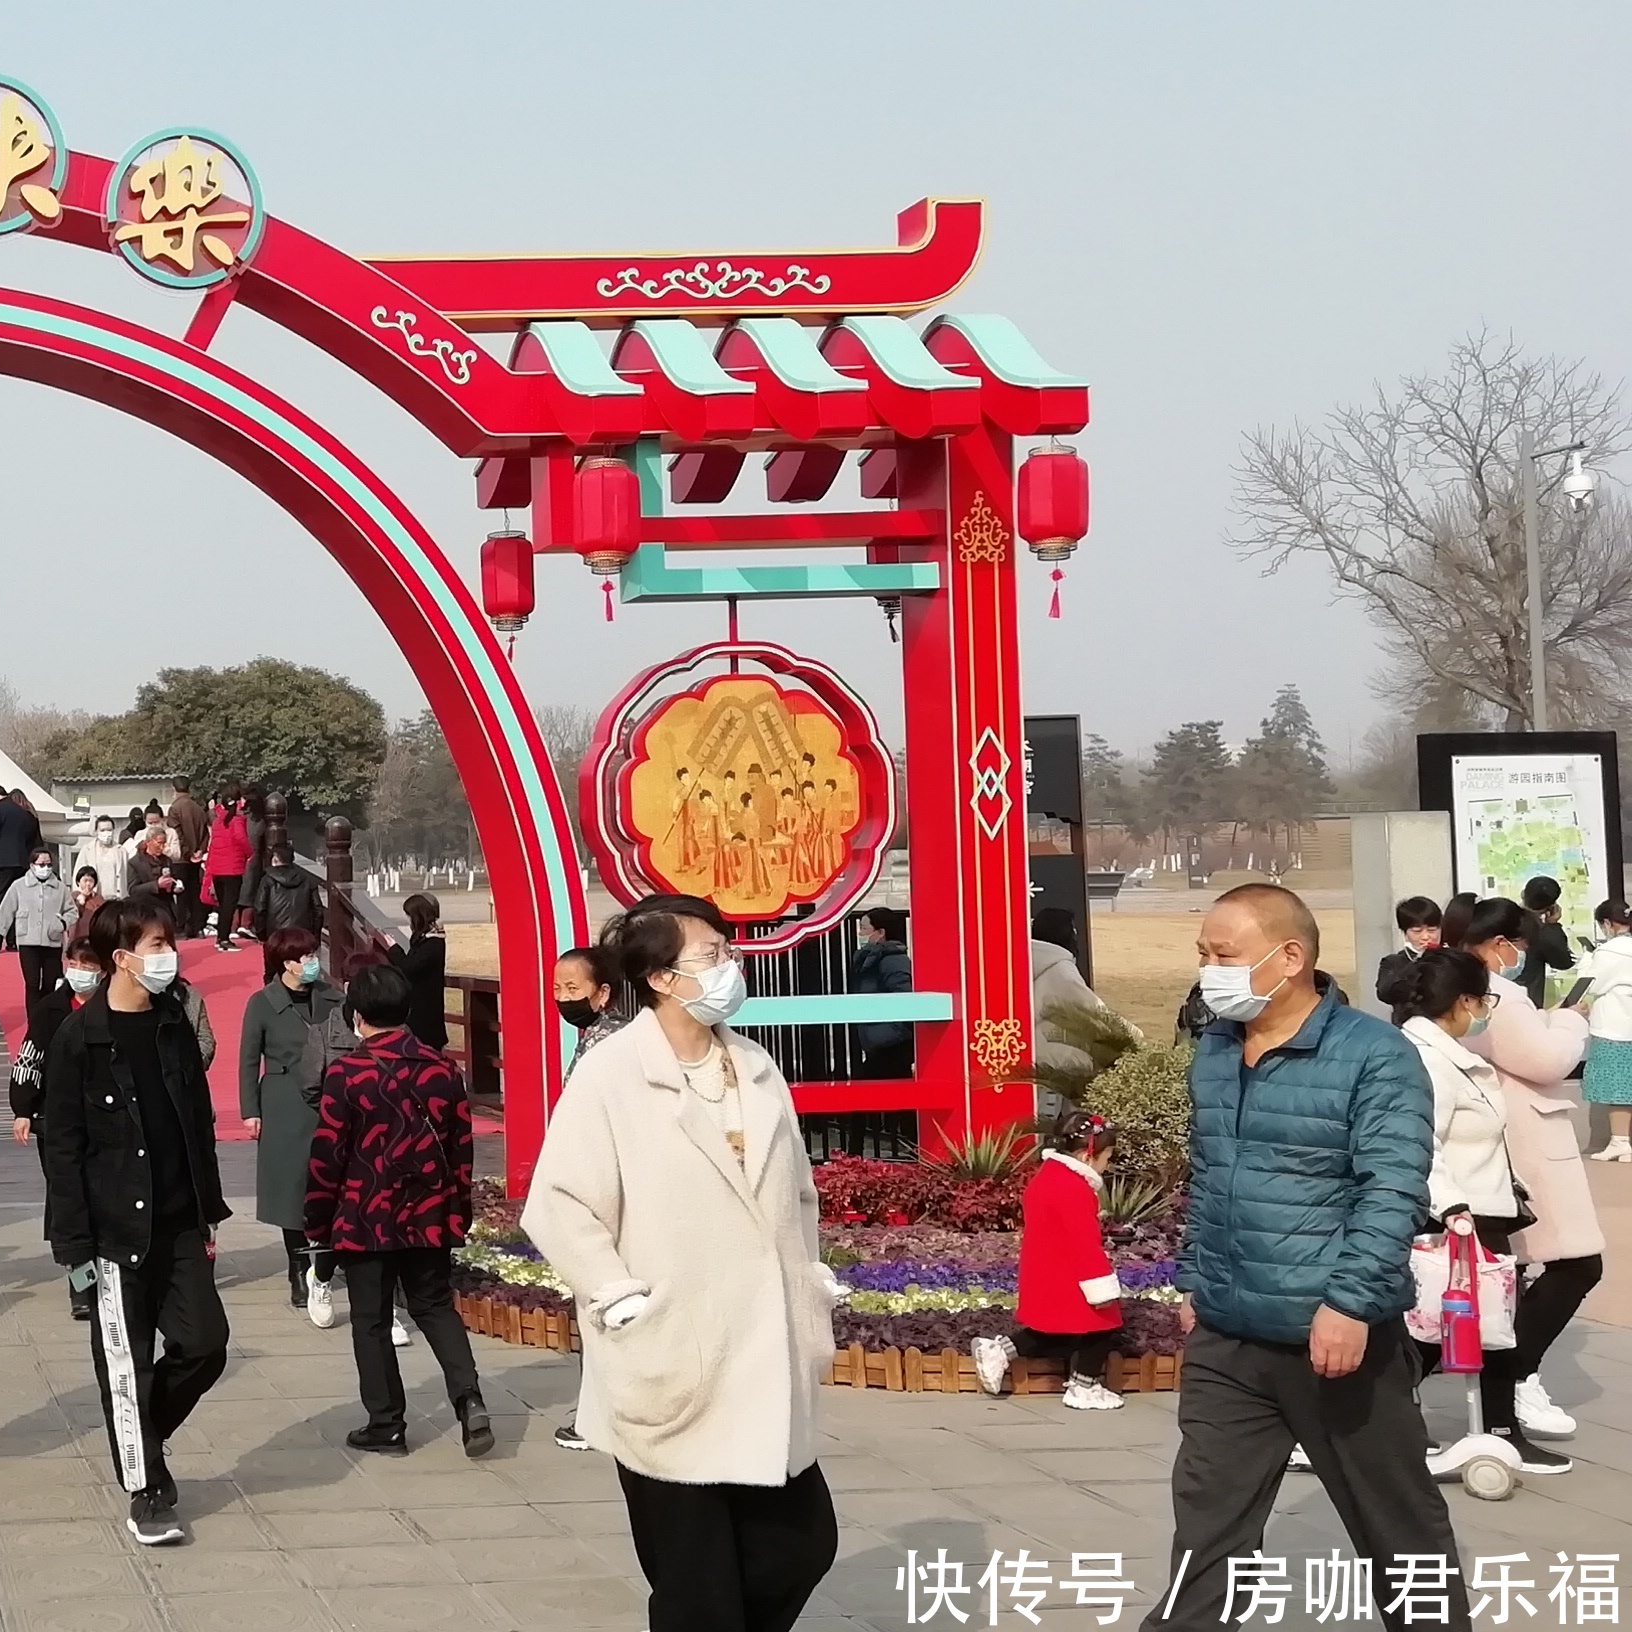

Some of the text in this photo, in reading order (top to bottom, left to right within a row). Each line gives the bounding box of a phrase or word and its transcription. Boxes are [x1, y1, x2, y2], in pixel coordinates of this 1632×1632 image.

[1508, 772, 1567, 784] 游园指南图
[1460, 780, 1504, 790] PALACE
